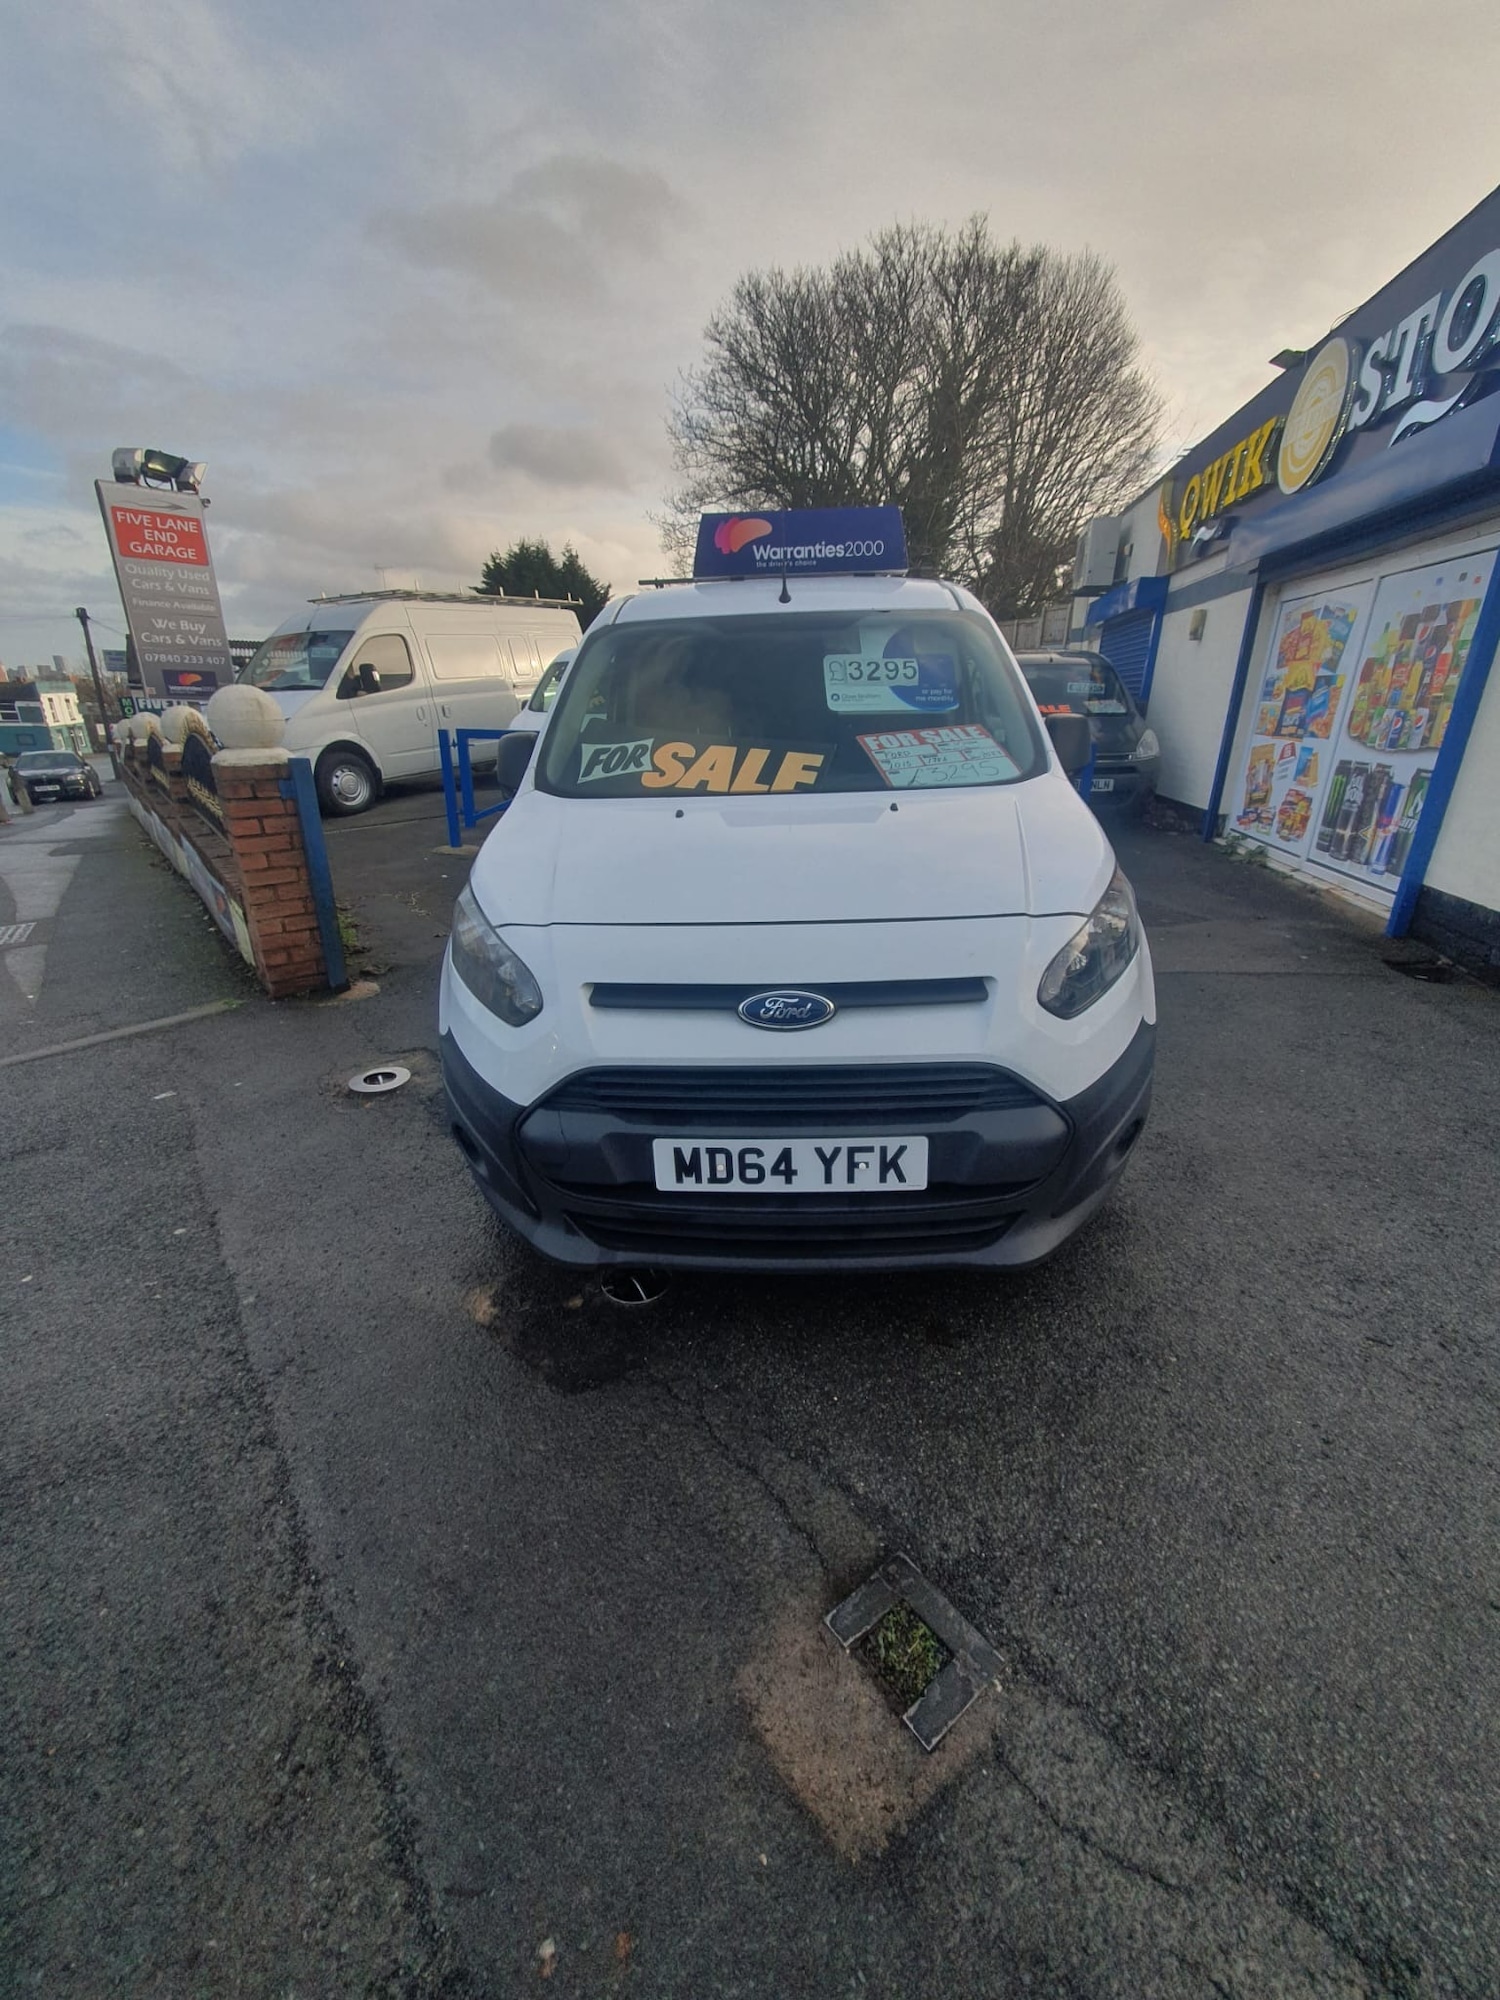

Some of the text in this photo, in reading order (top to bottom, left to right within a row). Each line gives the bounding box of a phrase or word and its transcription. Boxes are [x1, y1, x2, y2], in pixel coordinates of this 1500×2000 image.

[1180, 248, 1500, 539] QWIK STO
[116, 511, 199, 533] FIVE LANE
[144, 529, 178, 544] END
[129, 541, 198, 559] GARAGE
[752, 540, 885, 561] Warranties2000
[125, 563, 210, 582] Quality Used
[131, 578, 210, 595] Cars & Vans
[132, 598, 171, 609] Finance
[152, 618, 206, 635] We Buy
[141, 632, 222, 647] Cars & Vans
[144, 653, 225, 665] 07840 233 407
[121, 698, 134, 718] MO
[864, 726, 987, 750] FOR SALE
[581, 743, 649, 778] FOR
[760, 997, 812, 1019] Ford
[673, 1144, 908, 1184] MD64 YFK
